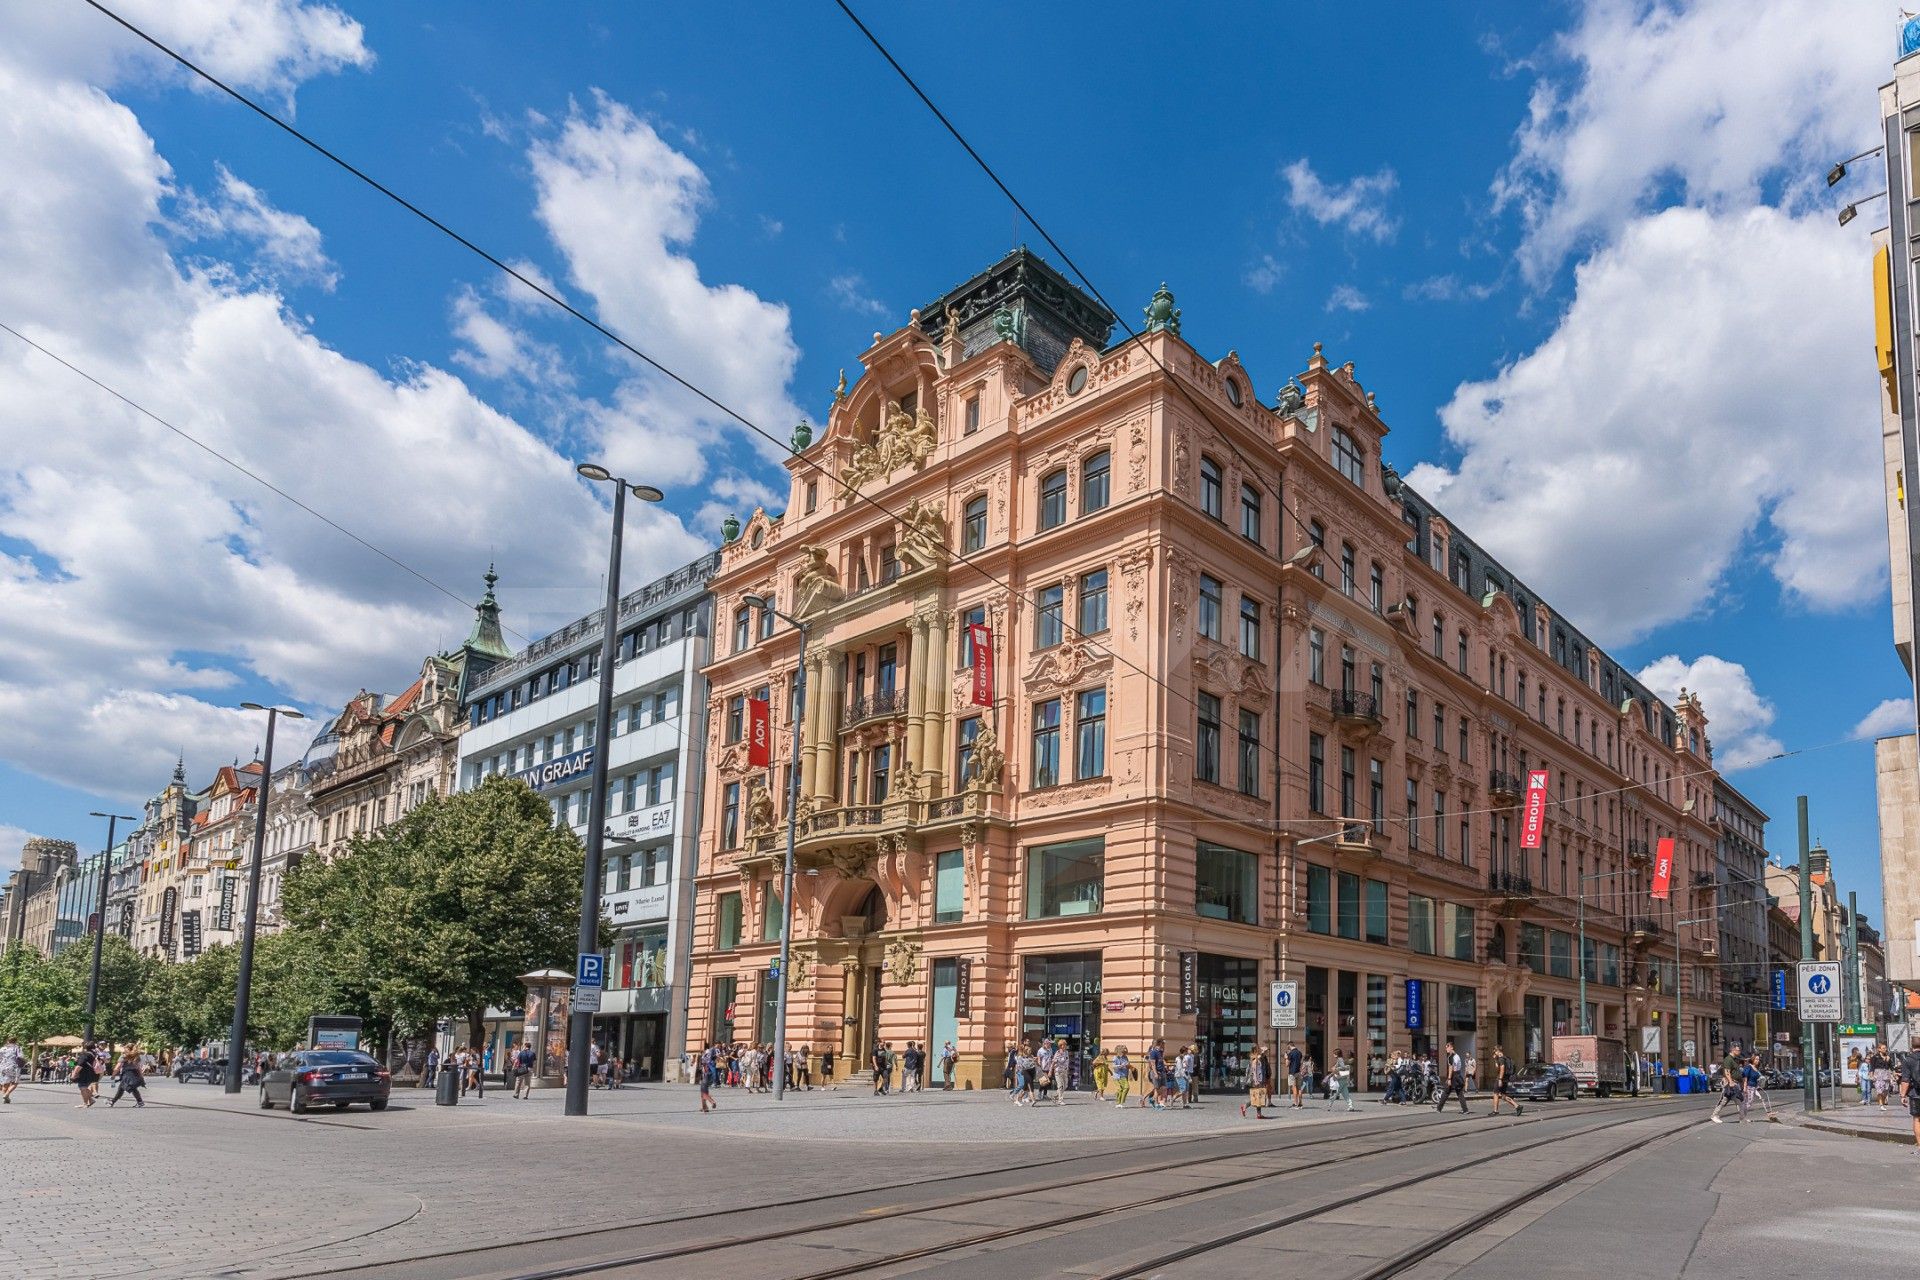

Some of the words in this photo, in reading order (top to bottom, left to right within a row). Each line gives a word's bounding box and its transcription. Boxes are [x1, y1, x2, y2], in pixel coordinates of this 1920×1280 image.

[979, 648, 987, 687] GROUP
[979, 690, 987, 702] IC
[754, 718, 766, 748] AON
[542, 751, 592, 784] GRAAF
[652, 809, 671, 827] EA7
[1528, 792, 1541, 831] GROUP
[1526, 833, 1537, 846] IC
[1658, 858, 1669, 879] AON
[220, 878, 234, 929] McDonald's
[583, 958, 599, 977] P
[958, 963, 967, 1013] SEPHORA
[1038, 981, 1102, 996] SEPHORA
